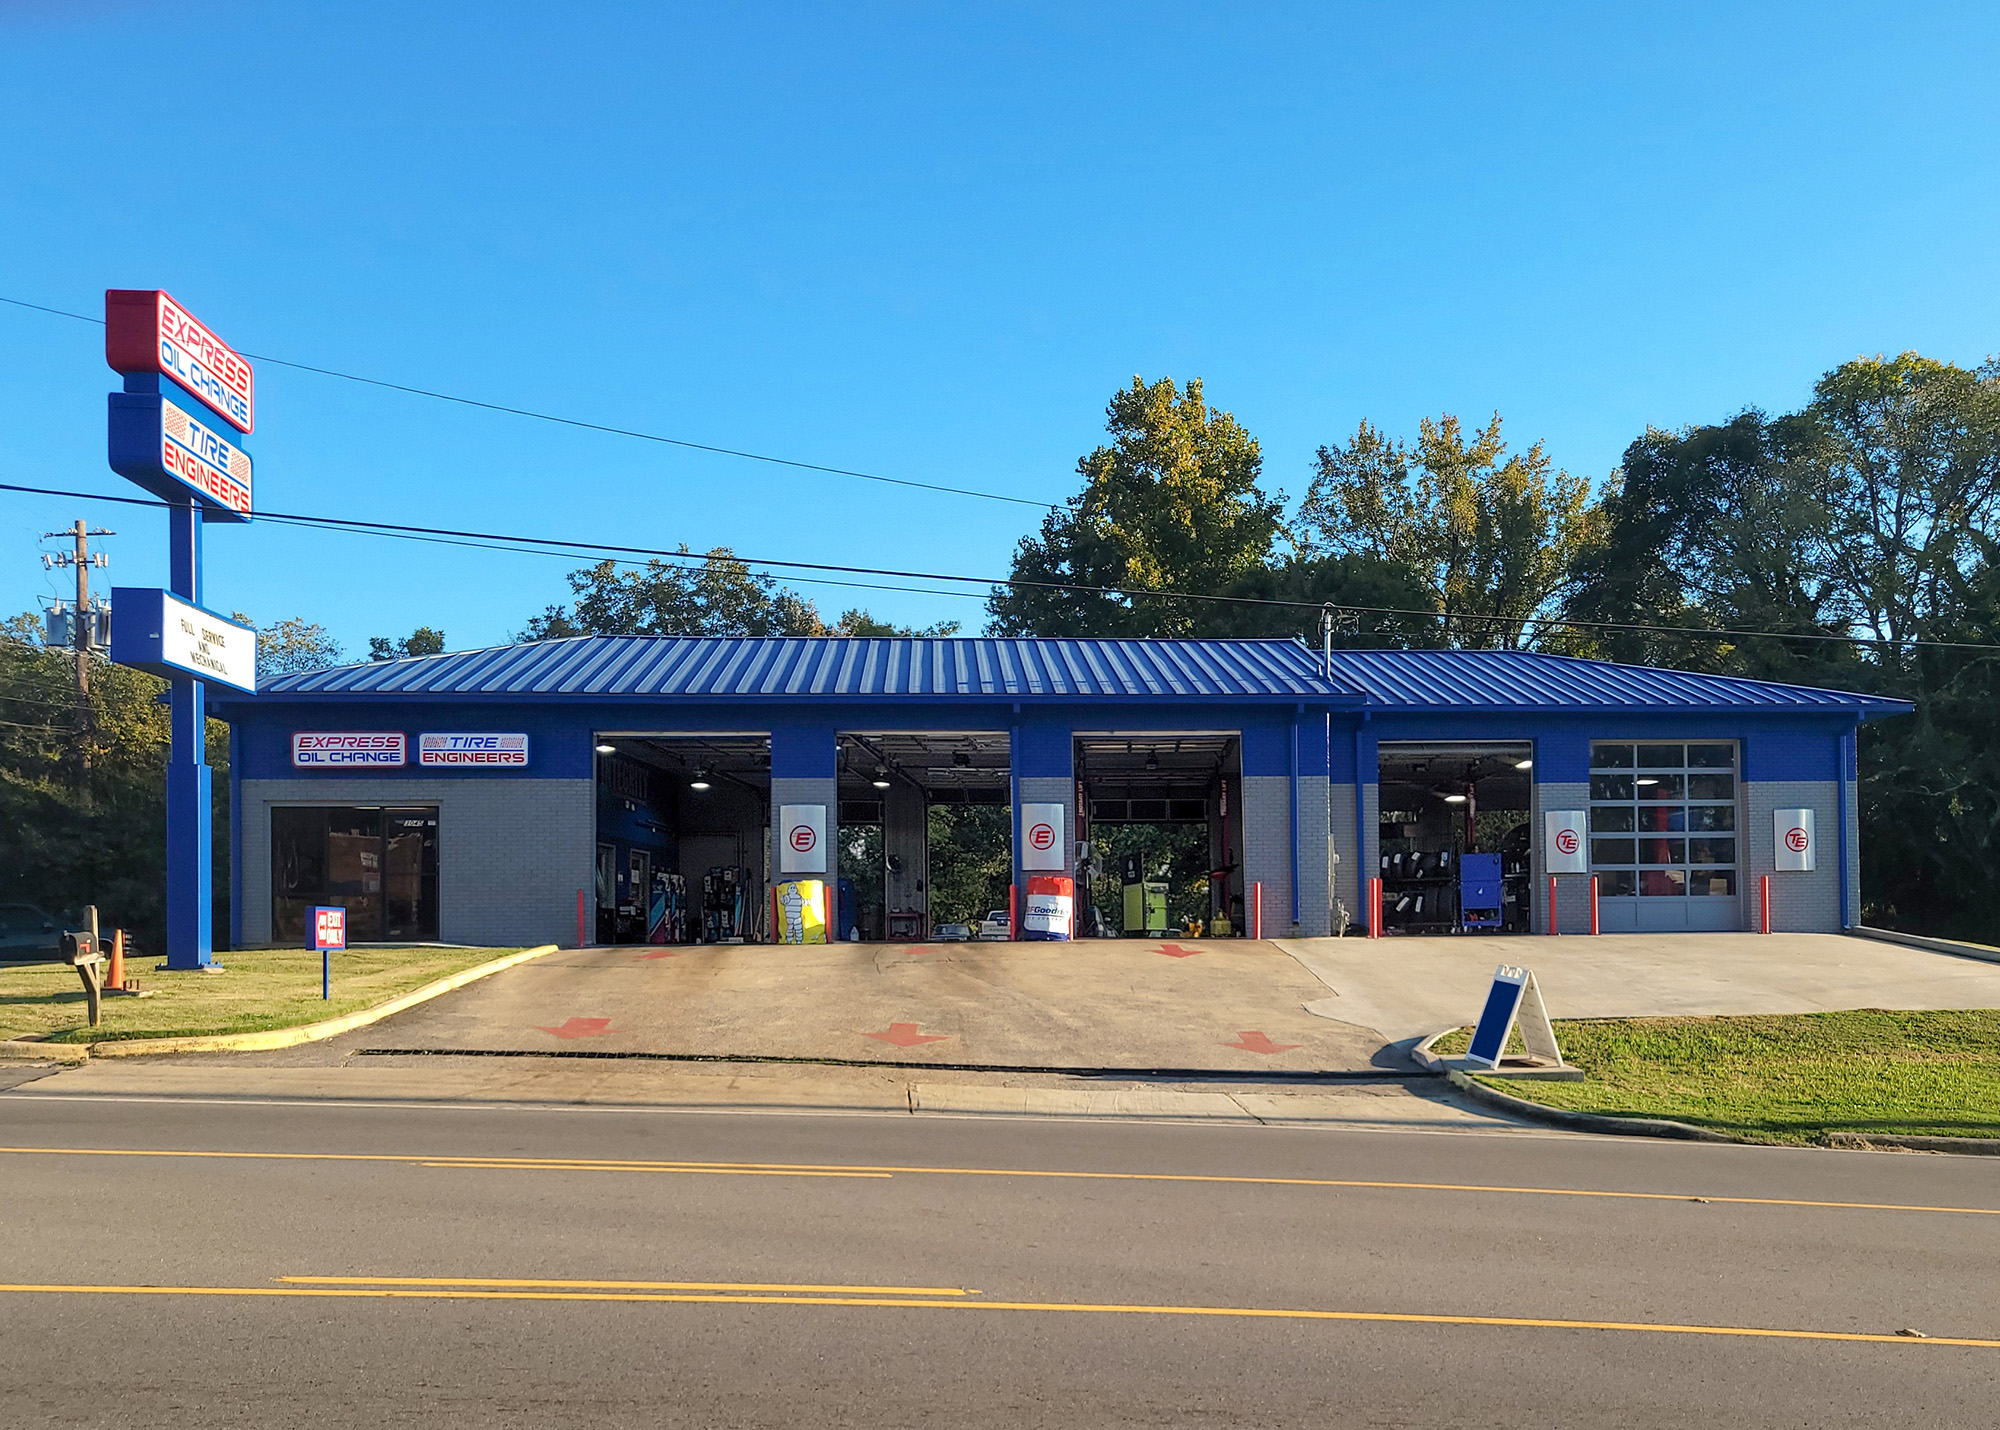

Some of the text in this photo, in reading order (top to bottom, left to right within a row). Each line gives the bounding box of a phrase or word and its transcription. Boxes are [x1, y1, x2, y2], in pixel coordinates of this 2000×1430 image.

[161, 304, 248, 392] EXPRESS
[162, 340, 248, 424] OIL CHANGE
[189, 421, 229, 469] TIRE
[164, 441, 249, 513] ENGINEERS
[181, 618, 226, 648] FULL SERVICE
[198, 640, 210, 656] AND
[190, 651, 228, 675] MECHANICAL
[298, 736, 401, 748] EXPRESS
[450, 736, 499, 748] TIRE
[298, 752, 401, 763] OIL CHANGE
[423, 752, 525, 763] ENGINEERS
[794, 832, 812, 846] E
[1034, 830, 1051, 844] E
[1561, 835, 1577, 849] TE
[1789, 833, 1806, 847] TE
[328, 912, 342, 927] EXIT
[327, 928, 343, 944] ONLY
